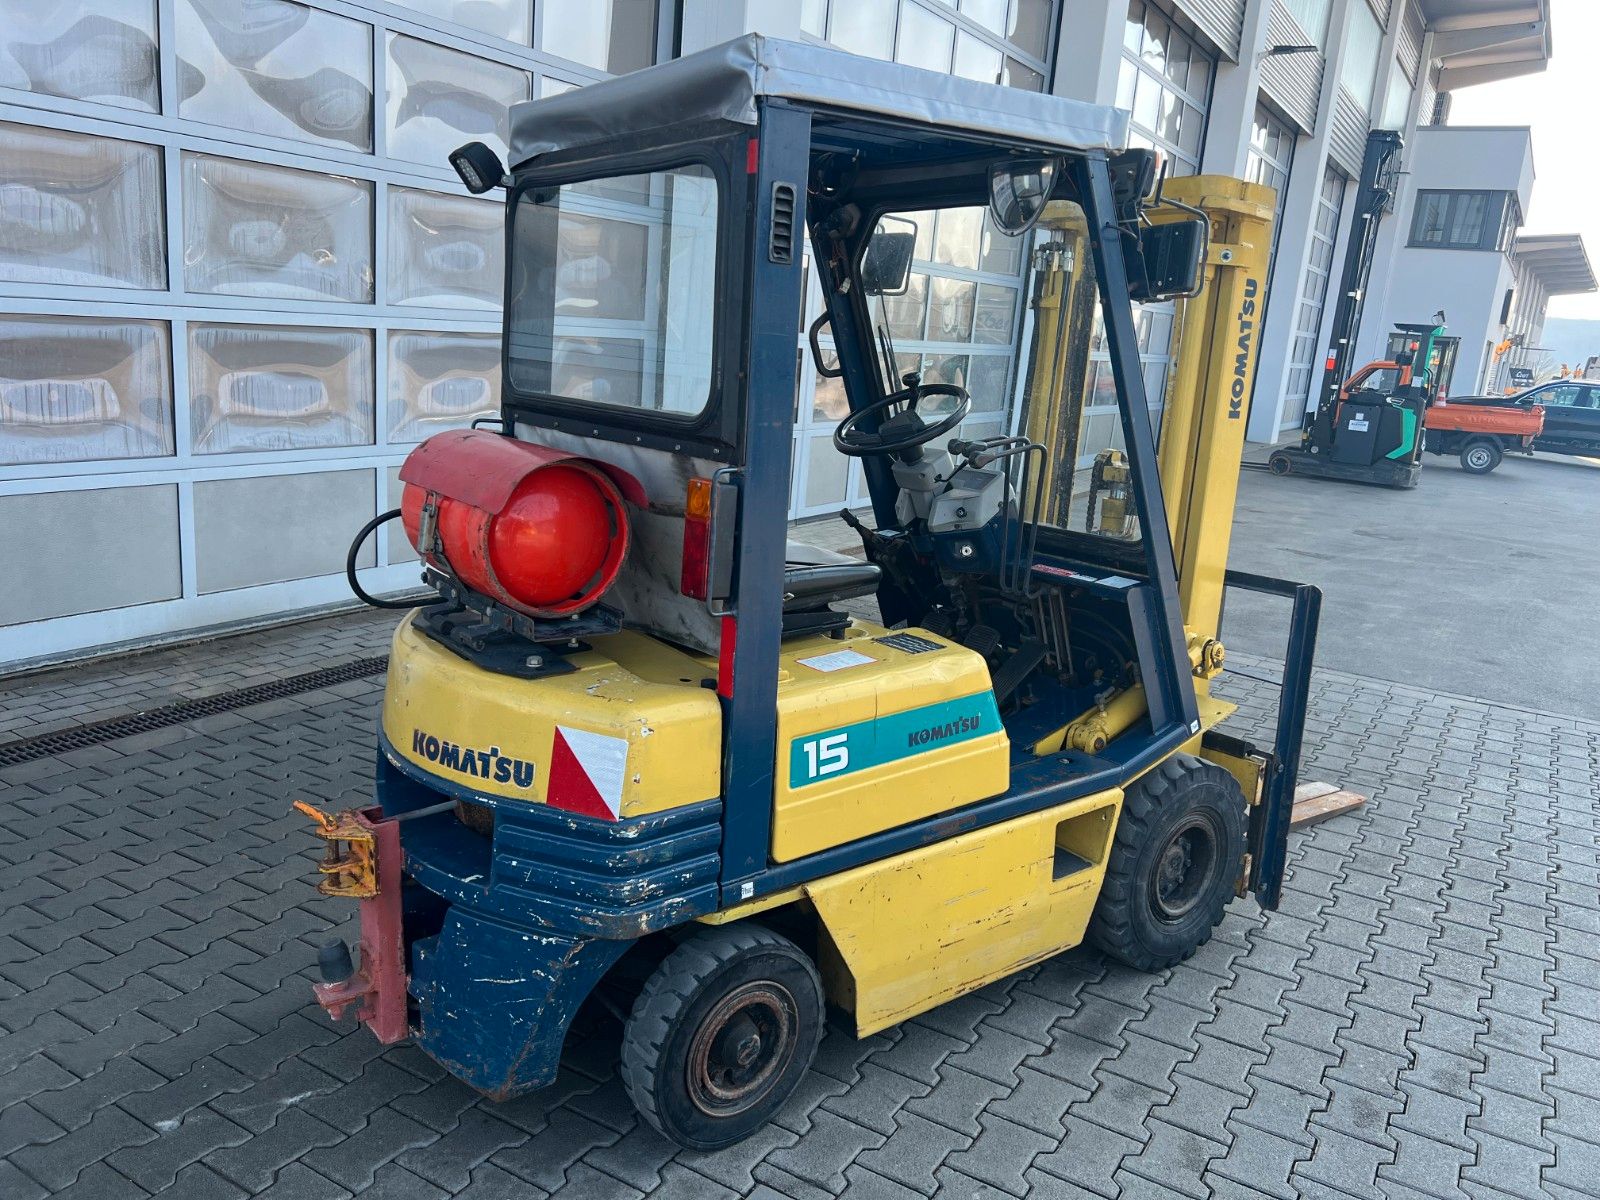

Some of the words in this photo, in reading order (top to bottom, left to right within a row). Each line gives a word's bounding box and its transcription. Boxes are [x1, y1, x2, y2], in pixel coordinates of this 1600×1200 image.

[1228, 278, 1258, 419] KOMATSU
[412, 728, 535, 788] KOMATSU
[803, 732, 849, 779] 15
[908, 716, 981, 748] KOMATSU
